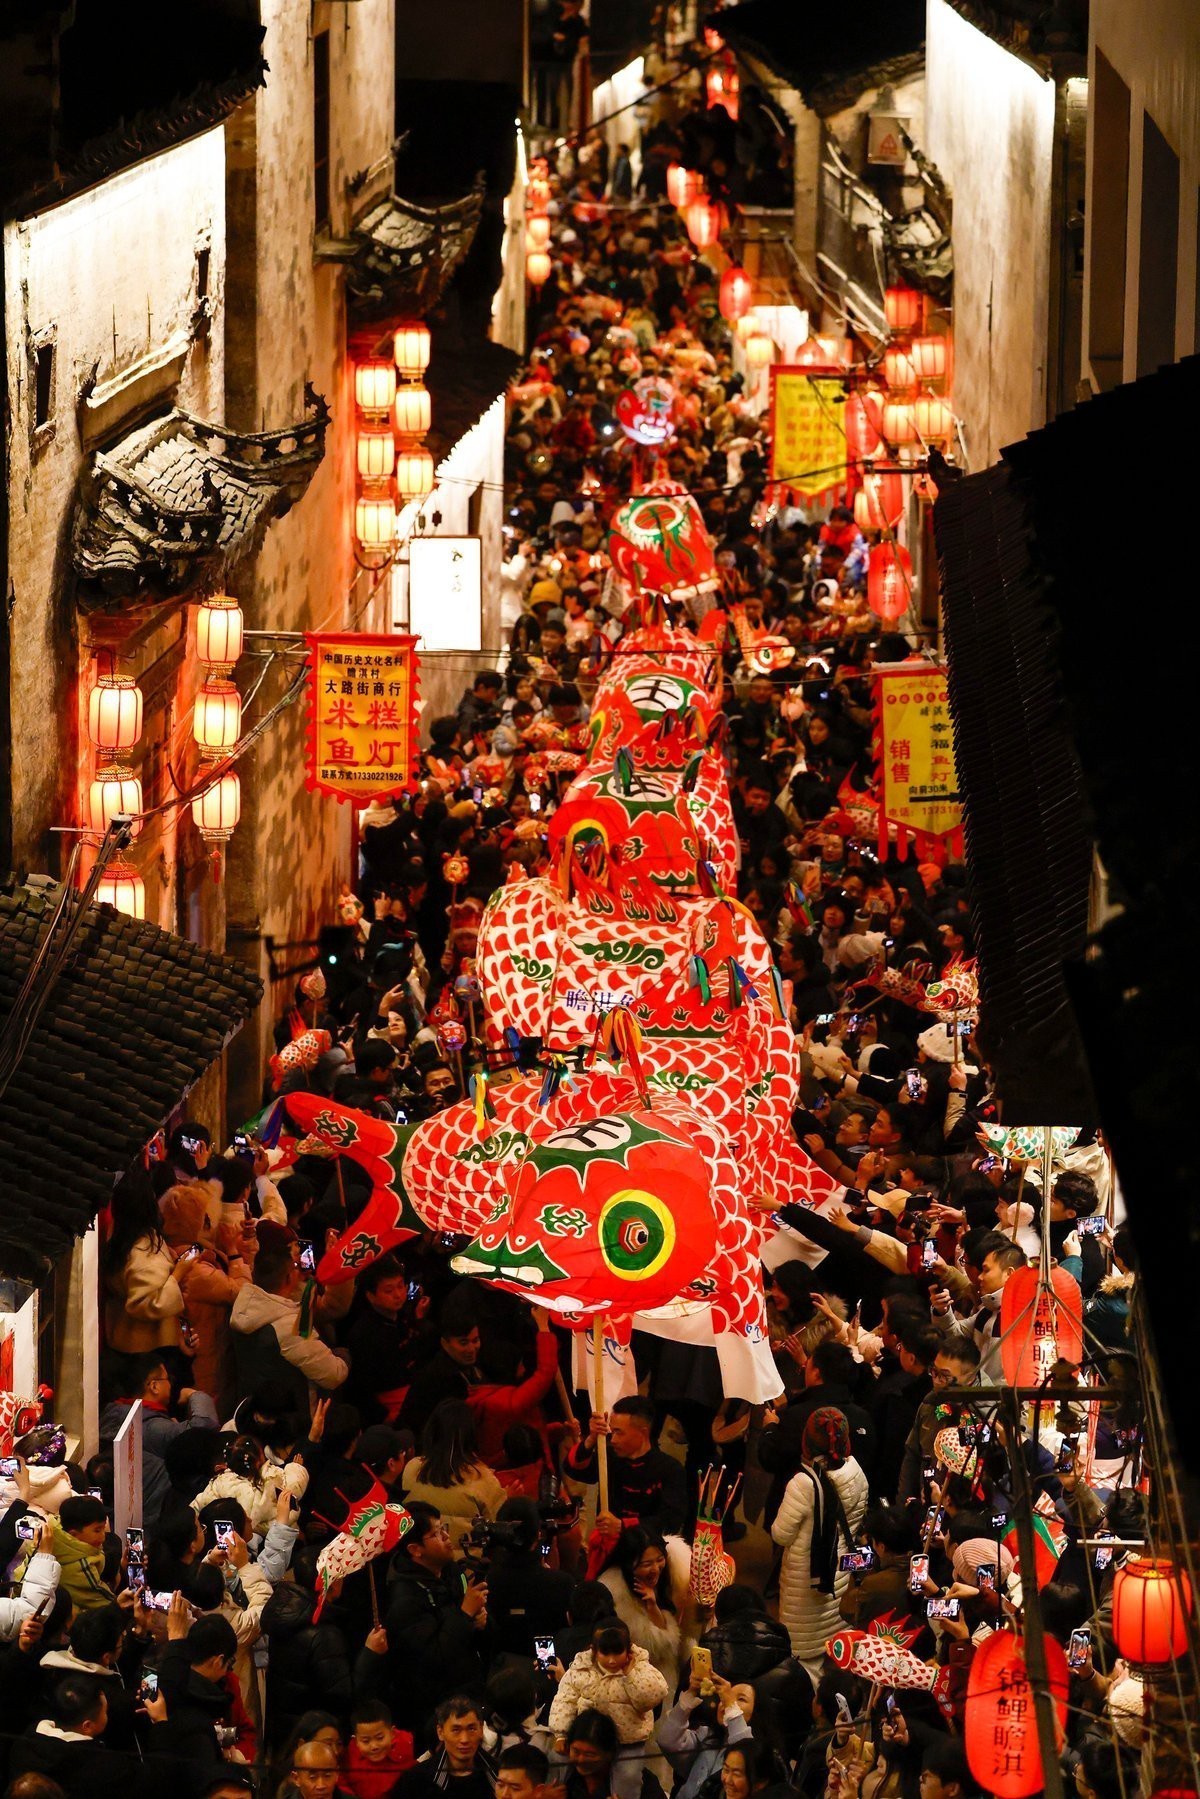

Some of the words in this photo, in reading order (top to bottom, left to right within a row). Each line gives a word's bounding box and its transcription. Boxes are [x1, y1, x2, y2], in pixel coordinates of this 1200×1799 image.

[324, 653, 403, 666] 中国历史文化名村
[325, 680, 401, 696] 大路街商行
[631, 678, 680, 709] 王
[324, 698, 402, 731] 米糕
[324, 737, 402, 768] 鱼灯
[889, 739, 911, 783] 销售
[321, 769, 403, 781] 联系方式17330221926
[908, 784, 948, 795] 向前30米
[547, 1118, 625, 1148] 王
[992, 1667, 1028, 1777] 锦鲤瞻淇
